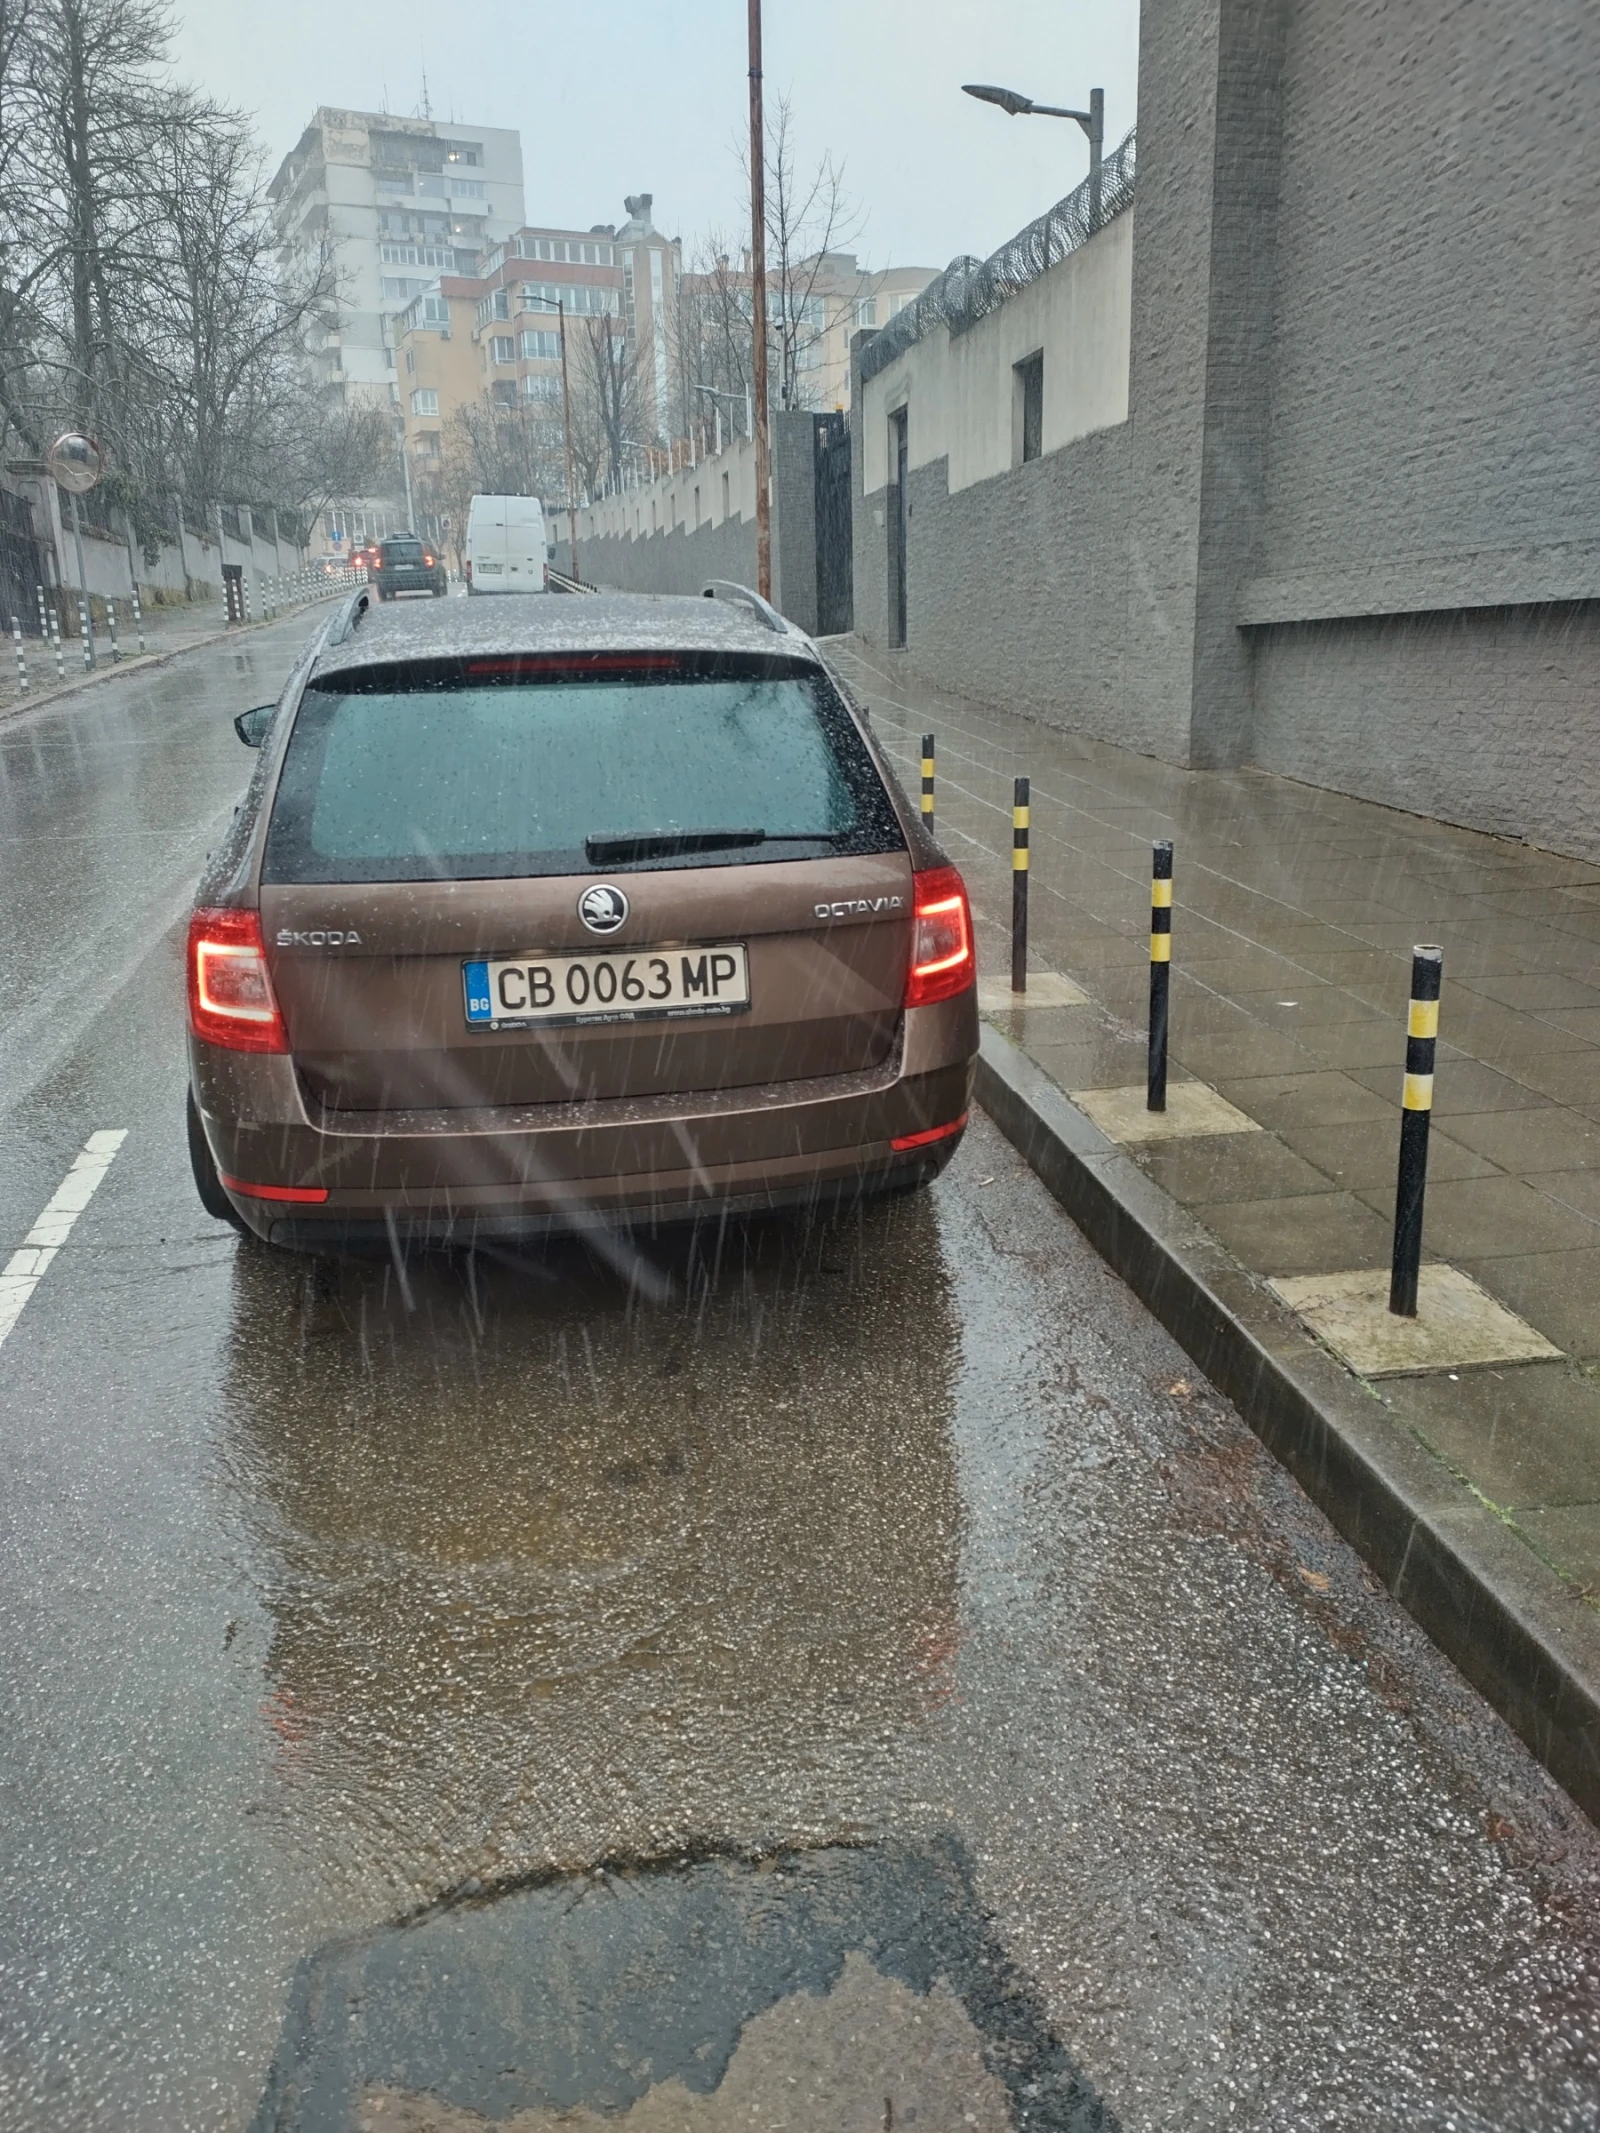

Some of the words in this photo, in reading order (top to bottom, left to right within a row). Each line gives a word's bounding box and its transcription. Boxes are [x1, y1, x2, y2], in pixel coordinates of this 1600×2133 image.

[814, 896, 904, 918] OCTAVIA
[276, 928, 363, 946] ŠKODA
[497, 966, 556, 1010] CB
[566, 958, 672, 1005] 0063
[681, 953, 737, 999] MP
[470, 998, 489, 1012] BG
